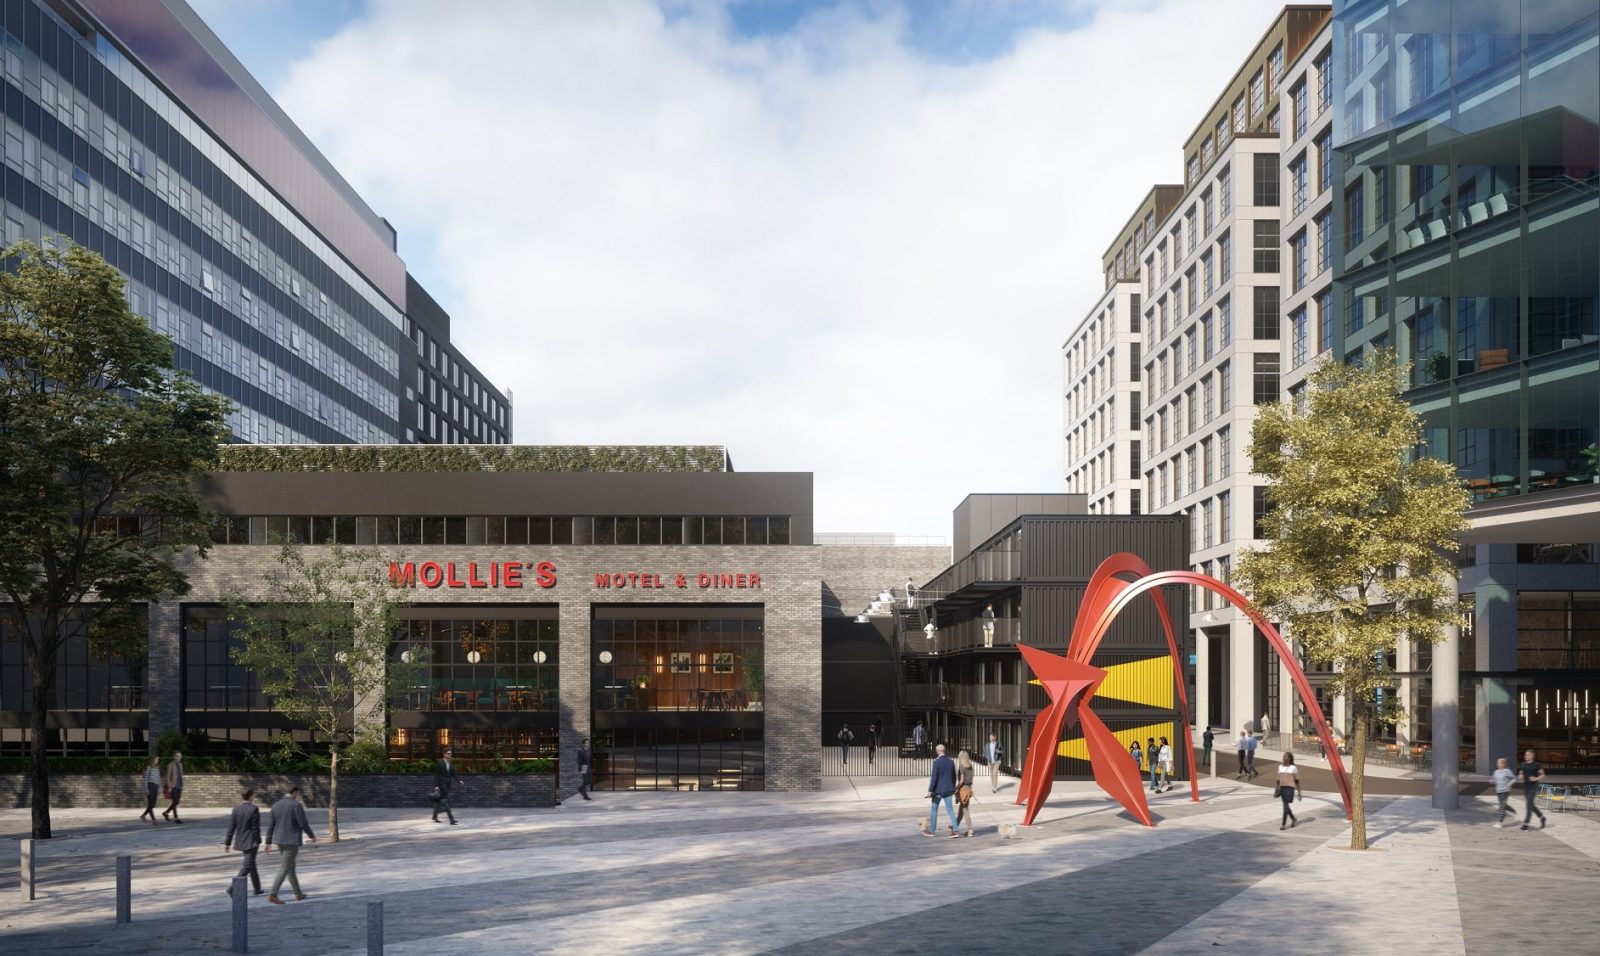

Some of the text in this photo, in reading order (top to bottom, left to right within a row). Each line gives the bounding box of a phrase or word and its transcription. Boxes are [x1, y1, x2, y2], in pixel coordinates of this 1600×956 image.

[389, 560, 557, 588] MOLLIE'S
[595, 573, 762, 588] MOTEL & DINER
